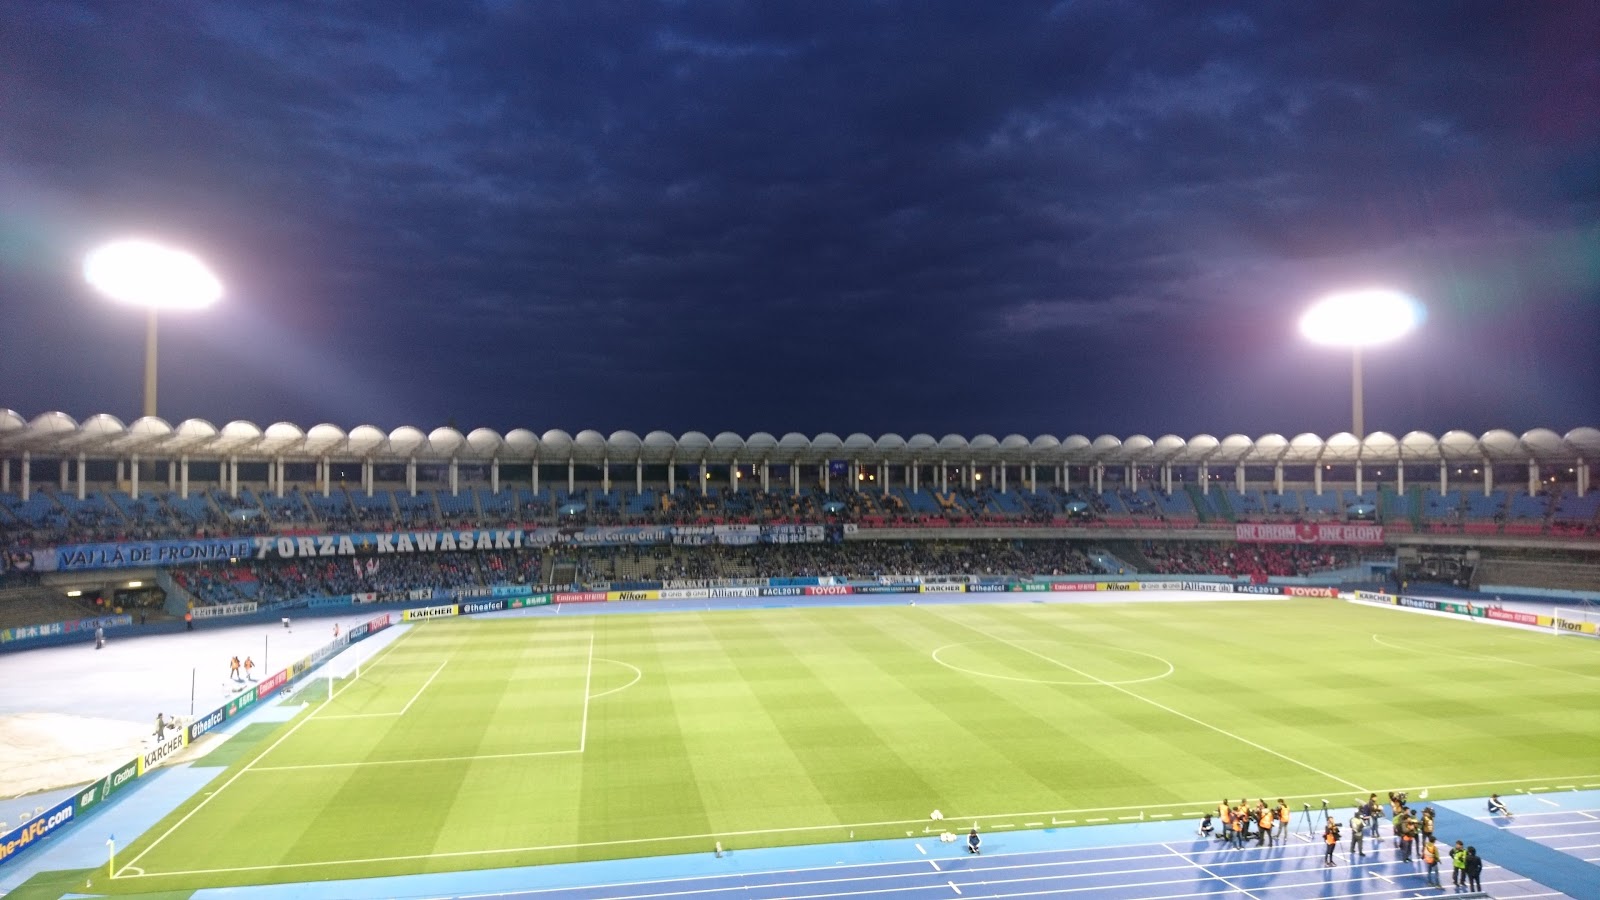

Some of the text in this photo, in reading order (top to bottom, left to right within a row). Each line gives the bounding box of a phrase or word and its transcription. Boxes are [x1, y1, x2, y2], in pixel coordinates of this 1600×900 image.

[1237, 525, 1296, 540] ONE DREAM
[1320, 526, 1382, 541] ONE GLORY
[605, 532, 637, 543] Carry
[255, 530, 521, 559] FORZA KAWASAKI
[62, 551, 94, 566] VAI
[131, 548, 152, 563] DE
[159, 543, 247, 559] FRONTALE
[662, 580, 707, 589] KAWASAKI
[1106, 583, 1130, 591] Nikon
[1185, 582, 1216, 591] Allianz
[711, 589, 743, 597] Allianz
[811, 587, 847, 595] TOYOTA
[1237, 586, 1279, 594] #ACL2019
[1290, 588, 1332, 597] TOYOTA
[556, 594, 583, 602] Emirates
[619, 591, 647, 600] Nikon
[191, 709, 223, 739] @theafccl
